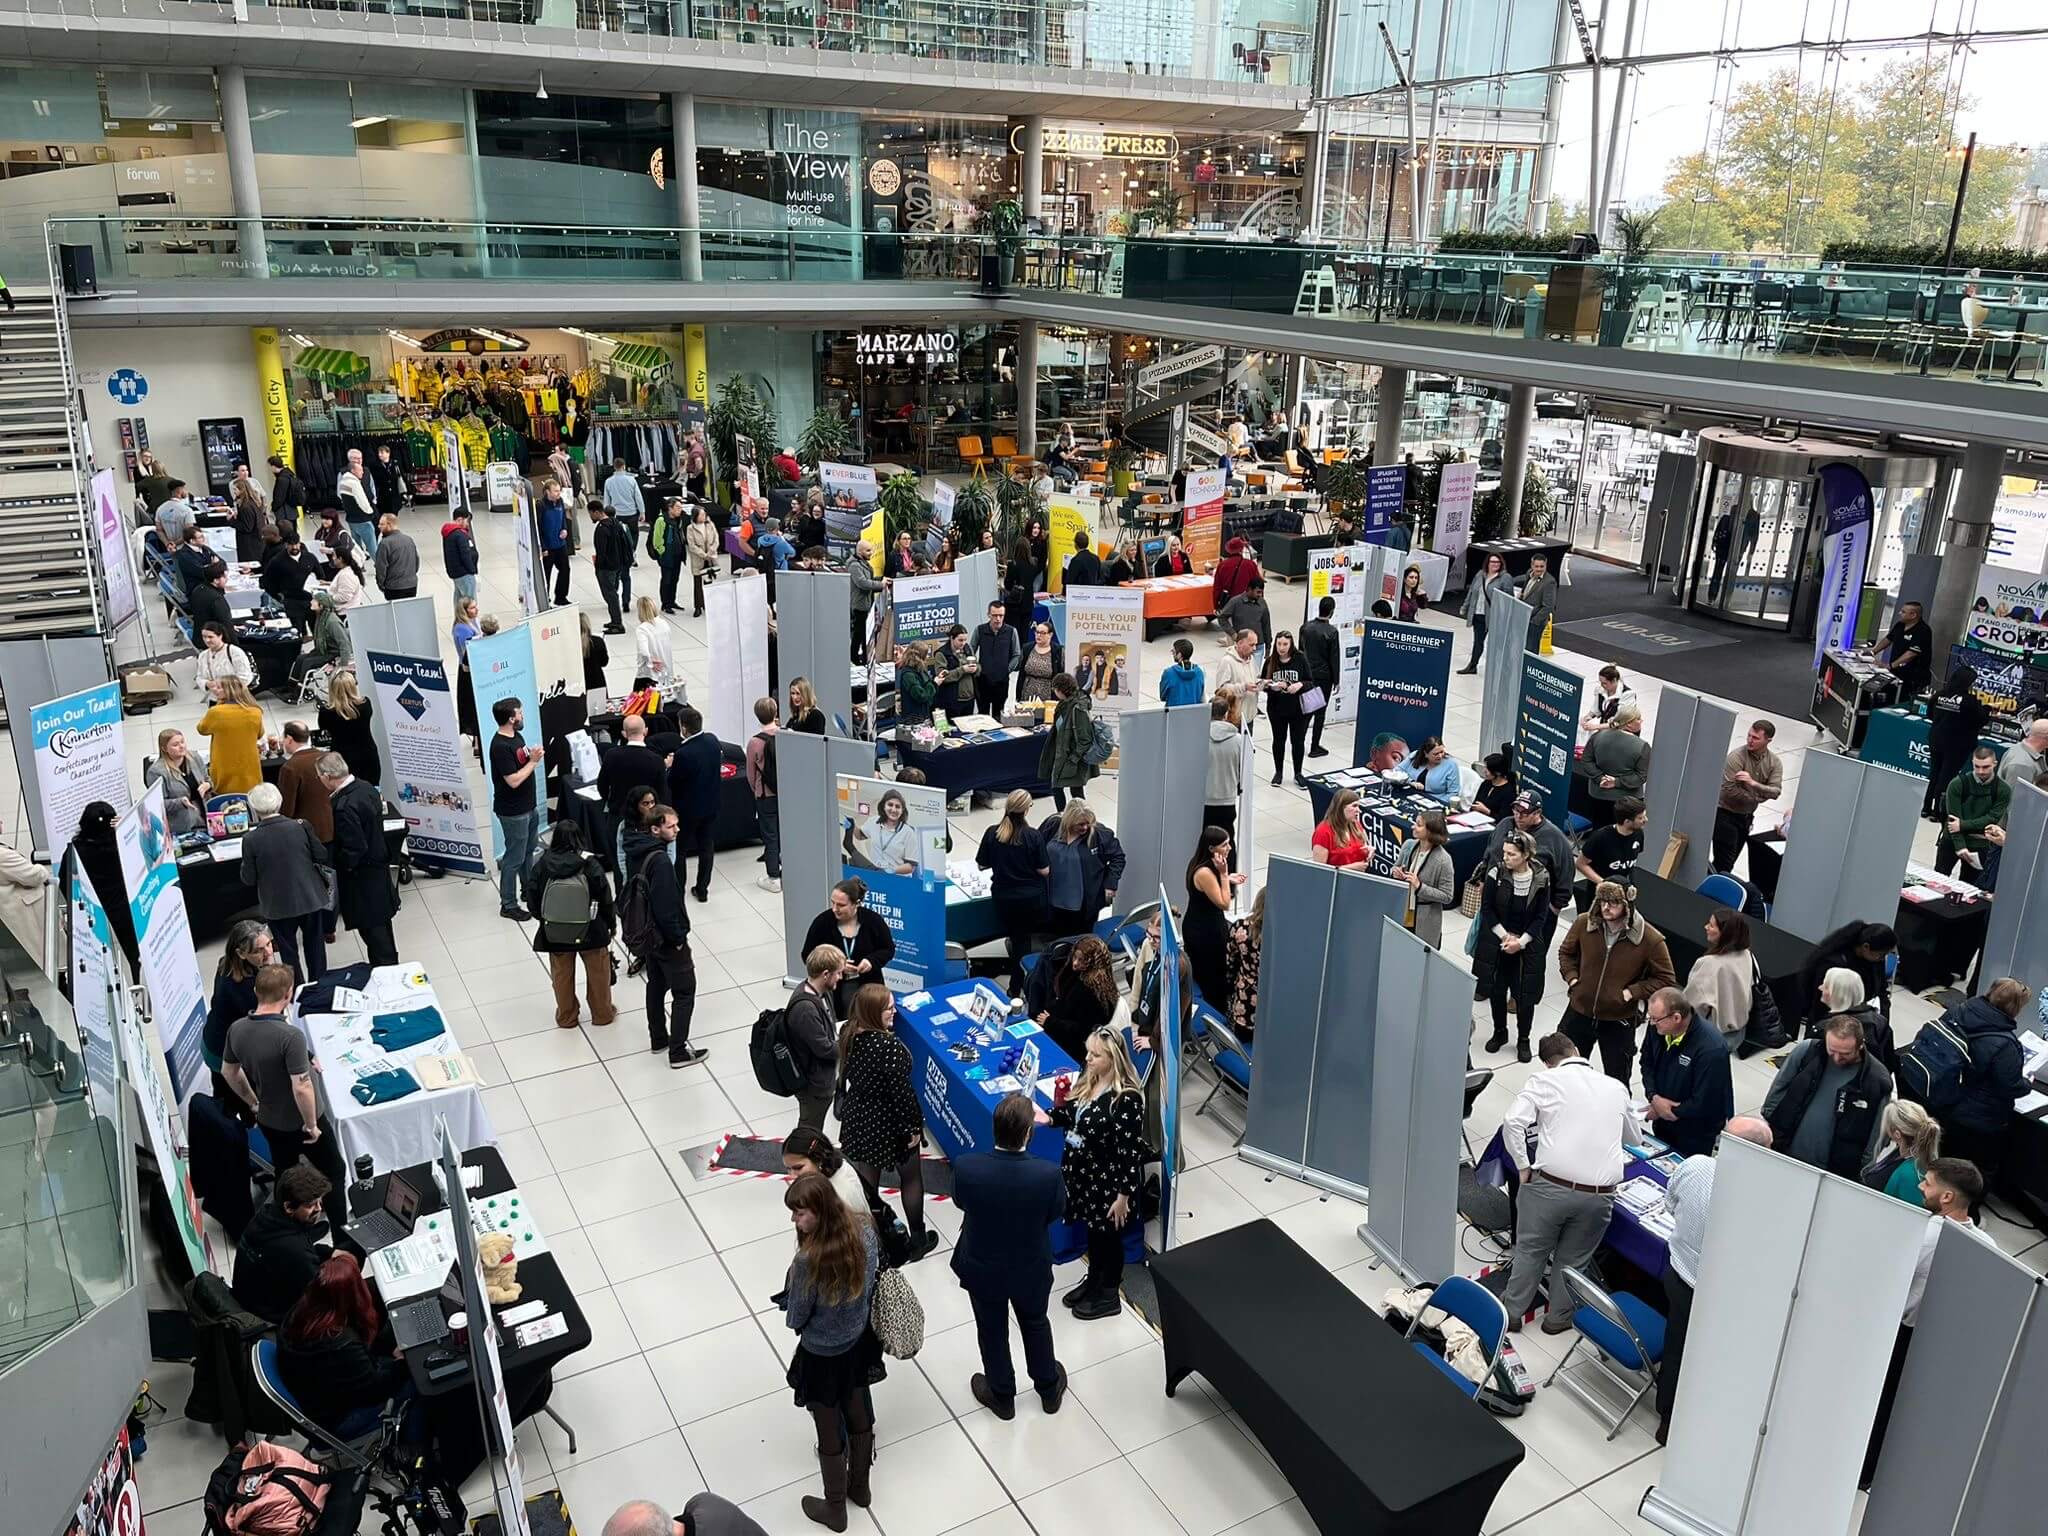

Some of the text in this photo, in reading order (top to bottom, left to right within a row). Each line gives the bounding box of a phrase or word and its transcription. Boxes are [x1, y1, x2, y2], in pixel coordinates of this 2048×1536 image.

[784, 123, 828, 148] The
[1042, 132, 1166, 154] ZZAEXPRESS
[784, 152, 848, 178] View
[786, 190, 834, 202] Multi-use
[786, 204, 822, 215] space
[787, 215, 824, 226] for hire
[856, 334, 954, 352] MARZANO
[856, 353, 954, 364] CAFE & BAR
[1148, 350, 1216, 378] PIZZAEXPRESS
[650, 361, 674, 380] CITY
[694, 370, 706, 392] City
[268, 378, 288, 458] The Stall City
[208, 444, 242, 454] MERLIN
[832, 470, 868, 481] EVERBLUE
[1314, 556, 1335, 570] JOBS
[1998, 580, 2041, 598] NOVA
[1997, 594, 2044, 608] TRAINING
[899, 607, 955, 623] THE FOOD
[1071, 612, 1137, 623] FULFIL YOUR
[1833, 604, 1844, 623] 25
[1977, 618, 2000, 626] STAND
[899, 616, 955, 631] INDUSTRY FROM
[923, 627, 934, 635] TO
[934, 624, 951, 634] FOR
[1075, 622, 1132, 632] POTENTIAL
[1371, 629, 1444, 648] HATCH BRENNER
[1386, 642, 1424, 654] SOLICITORS
[374, 661, 443, 679] Join Our Team!
[1367, 677, 1438, 696] Legal clarity is
[1526, 665, 1575, 694] HATCH BRENNER
[1366, 689, 1429, 708] for everyone
[1536, 682, 1562, 698] SOLICITORS
[37, 692, 117, 734] Join Our Team!
[1526, 694, 1570, 723] Here to help you
[57, 723, 112, 755] Kinnerton
[871, 891, 886, 904] THE
[872, 904, 901, 918] STEP IN
[884, 917, 904, 930] REER
[926, 1055, 948, 1094] NHS
[944, 1101, 976, 1148] Community
